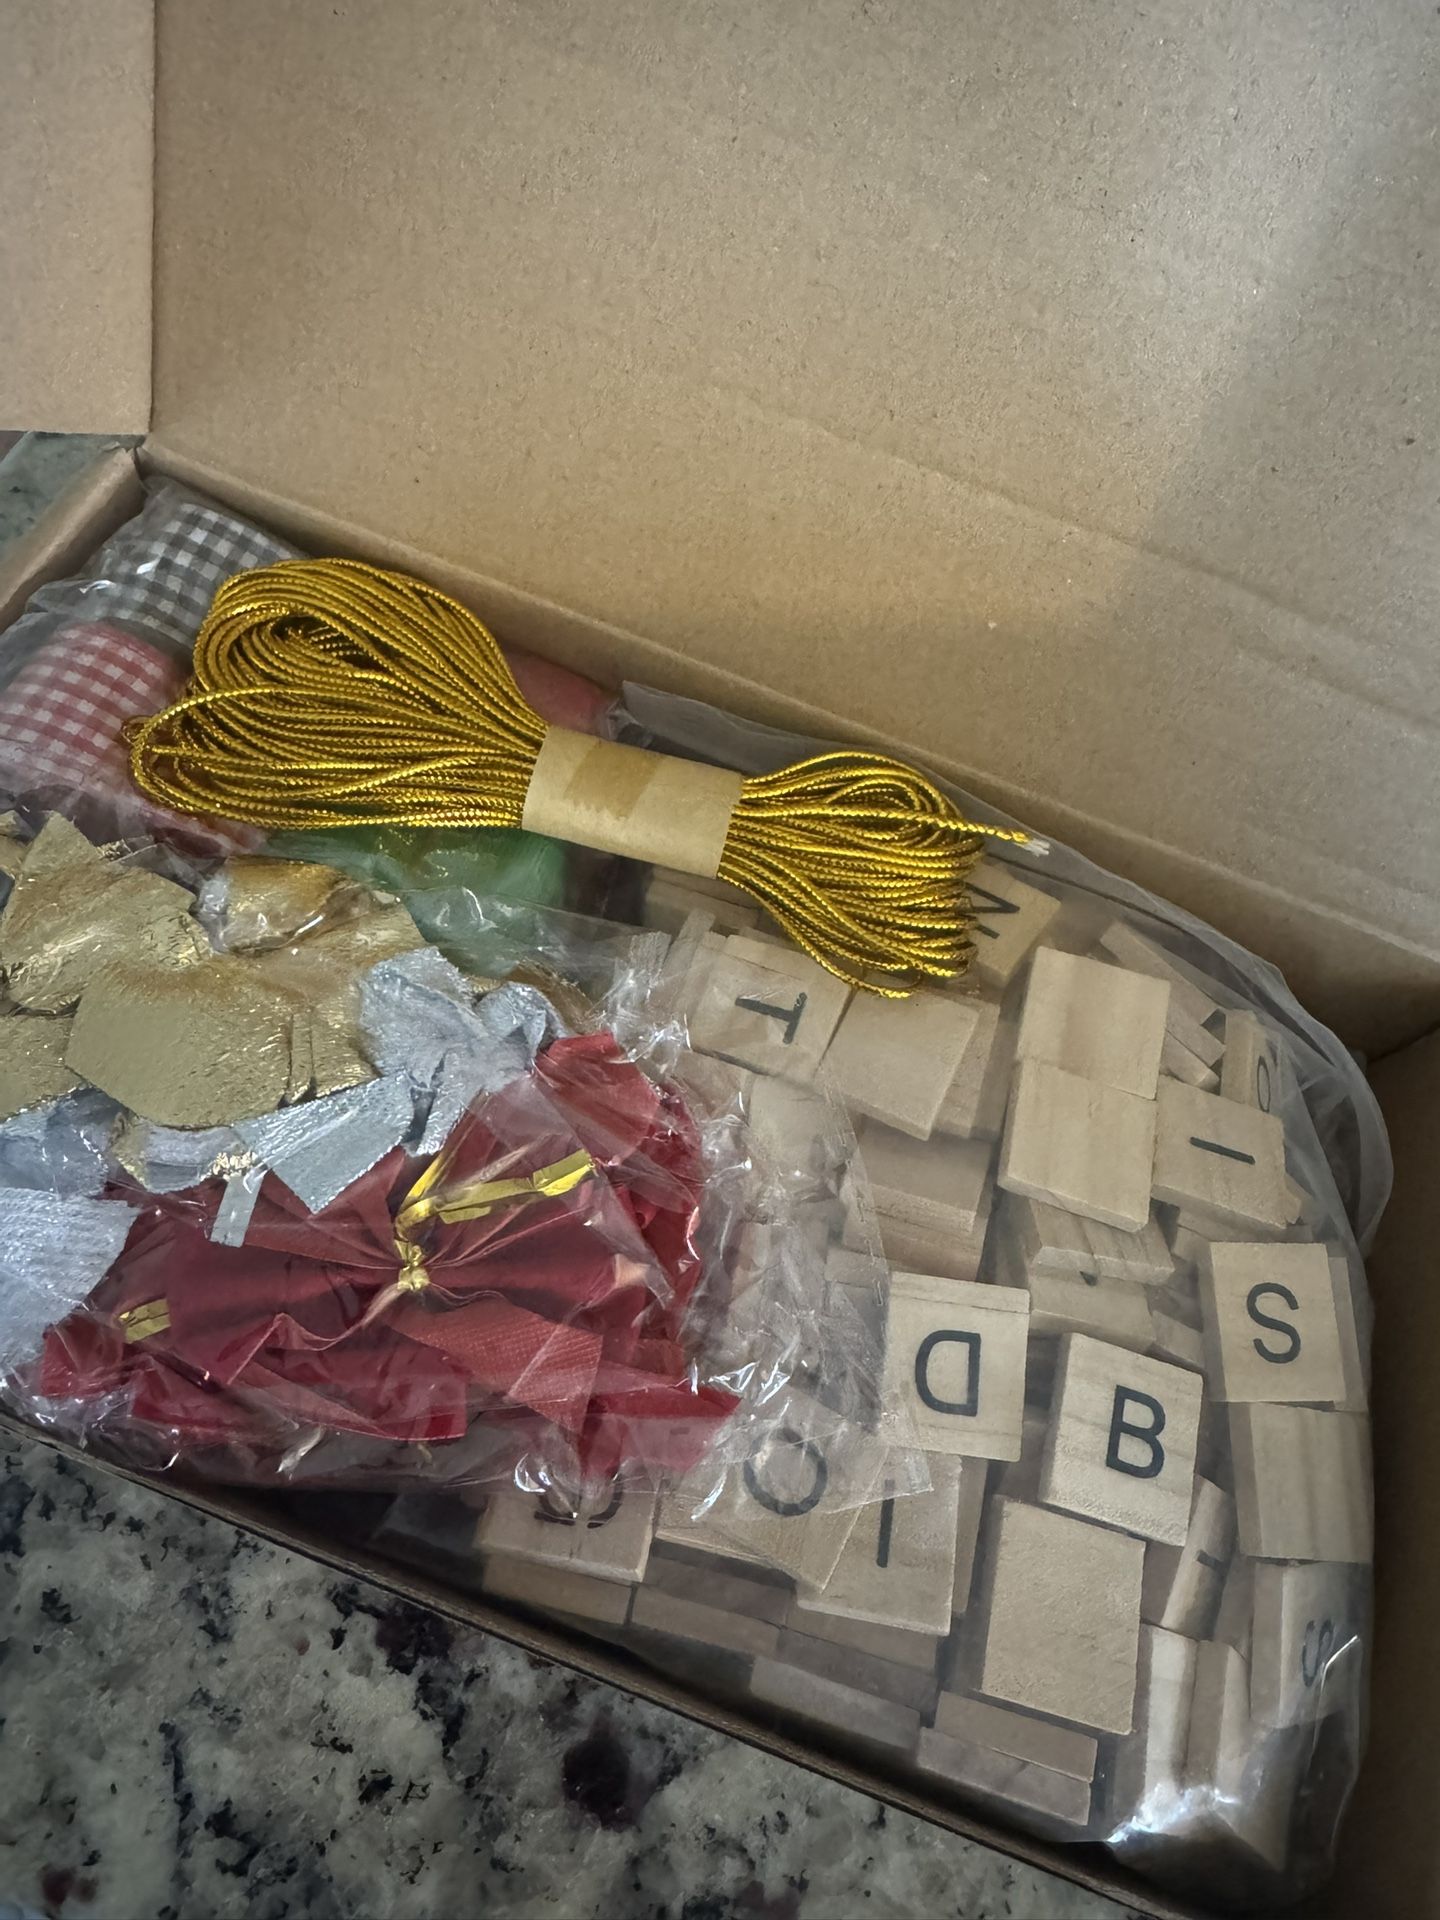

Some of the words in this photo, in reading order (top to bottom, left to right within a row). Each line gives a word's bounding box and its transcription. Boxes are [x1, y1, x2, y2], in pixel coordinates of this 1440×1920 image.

[735, 993, 807, 1045] T
[1246, 1282, 1301, 1364] S
[915, 1330, 981, 1417] D
[743, 1422, 827, 1516] O
[1106, 1385, 1165, 1478] B
